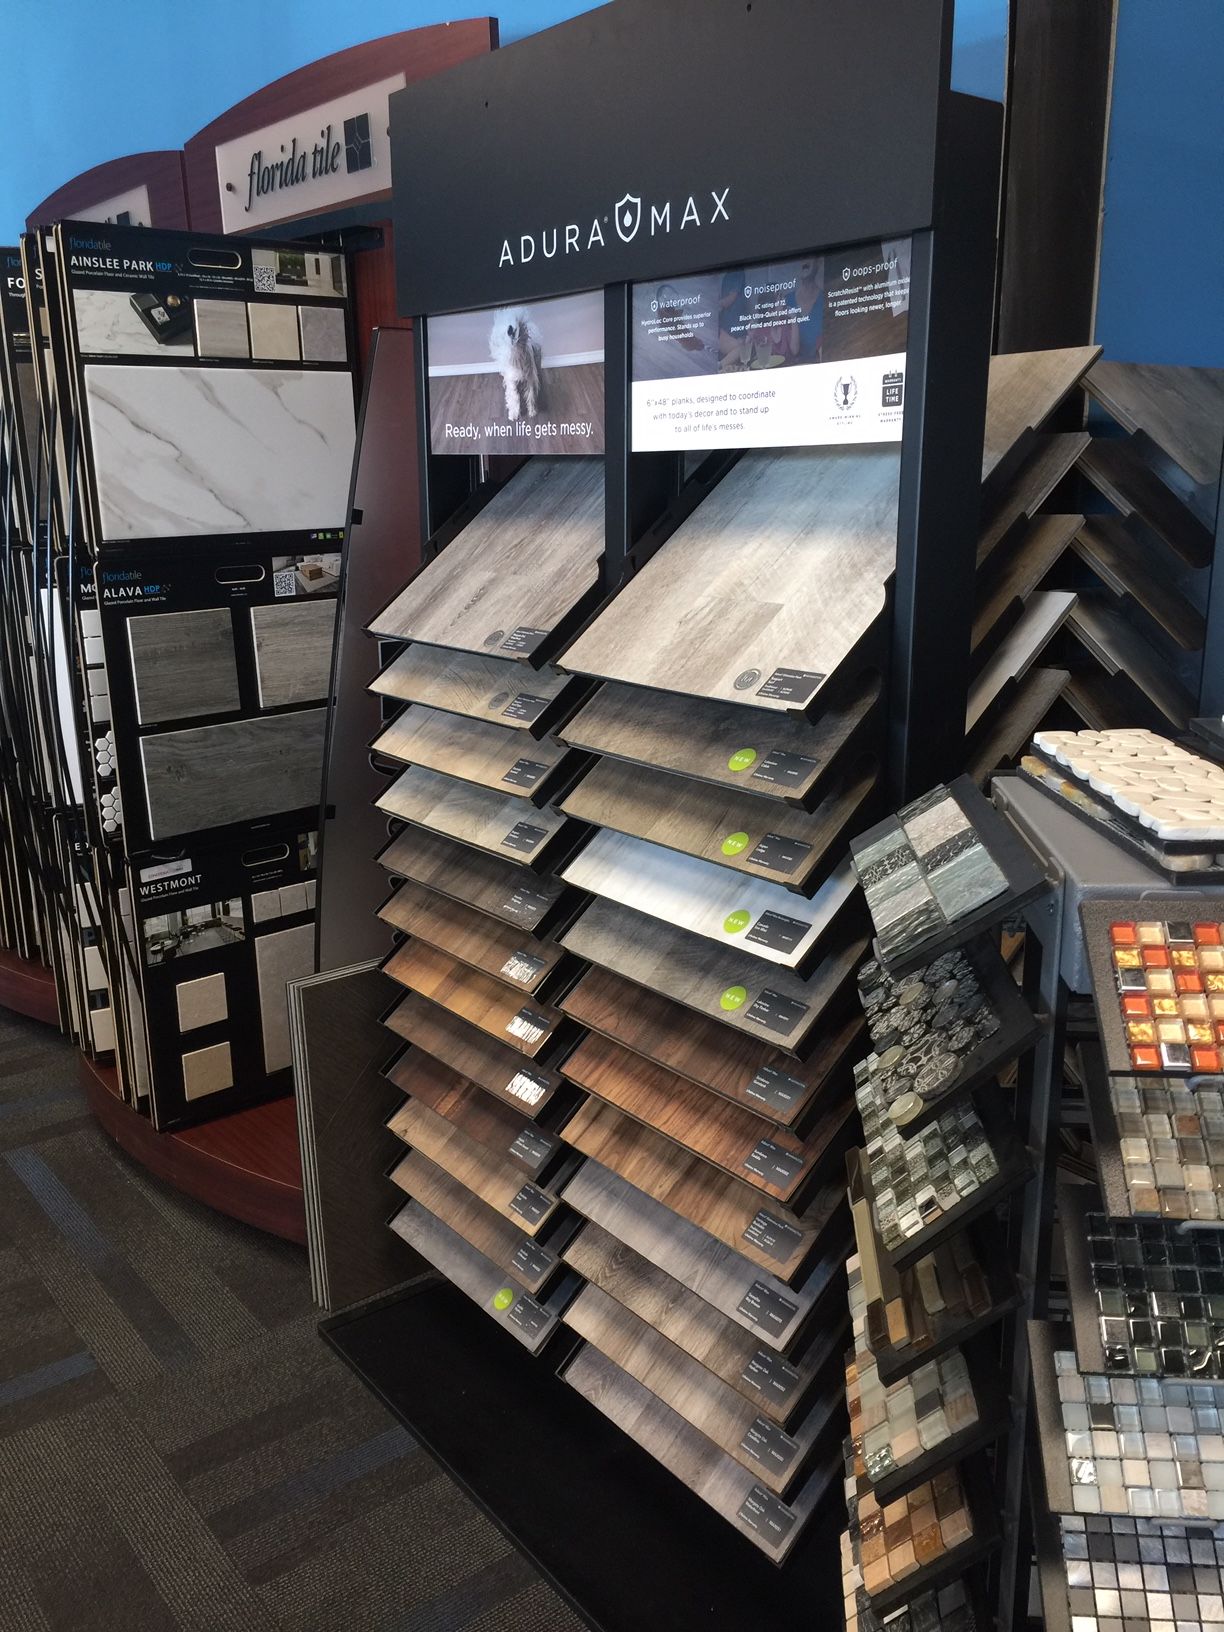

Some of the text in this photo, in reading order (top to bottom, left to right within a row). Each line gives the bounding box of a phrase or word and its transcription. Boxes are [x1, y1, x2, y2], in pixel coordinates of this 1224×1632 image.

[244, 124, 342, 213] florida tile
[650, 187, 731, 237] MAX
[70, 255, 120, 270] AINSLEE
[123, 259, 154, 272] PARK
[852, 257, 898, 277] oops-proof
[754, 278, 796, 294] noiseproof
[660, 294, 701, 310] waterproof
[837, 297, 858, 307] patented
[858, 292, 884, 303] technology
[693, 312, 712, 321] superior
[834, 309, 849, 317] floors
[850, 306, 868, 315] looking
[696, 394, 727, 404] designed
[738, 390, 776, 400] coordinate
[653, 413, 667, 421] with
[668, 410, 693, 420] today's
[715, 408, 728, 416] and
[739, 406, 758, 415] stand
[759, 406, 770, 415] up
[445, 421, 594, 440] Ready, when life gets messy.
[683, 424, 691, 432] all
[693, 424, 700, 432] of
[701, 423, 717, 432] life's
[103, 586, 143, 599] ALAVA
[139, 874, 202, 896] WESTMONT
[729, 918, 744, 926] NEW
[725, 994, 740, 1003] NEW
